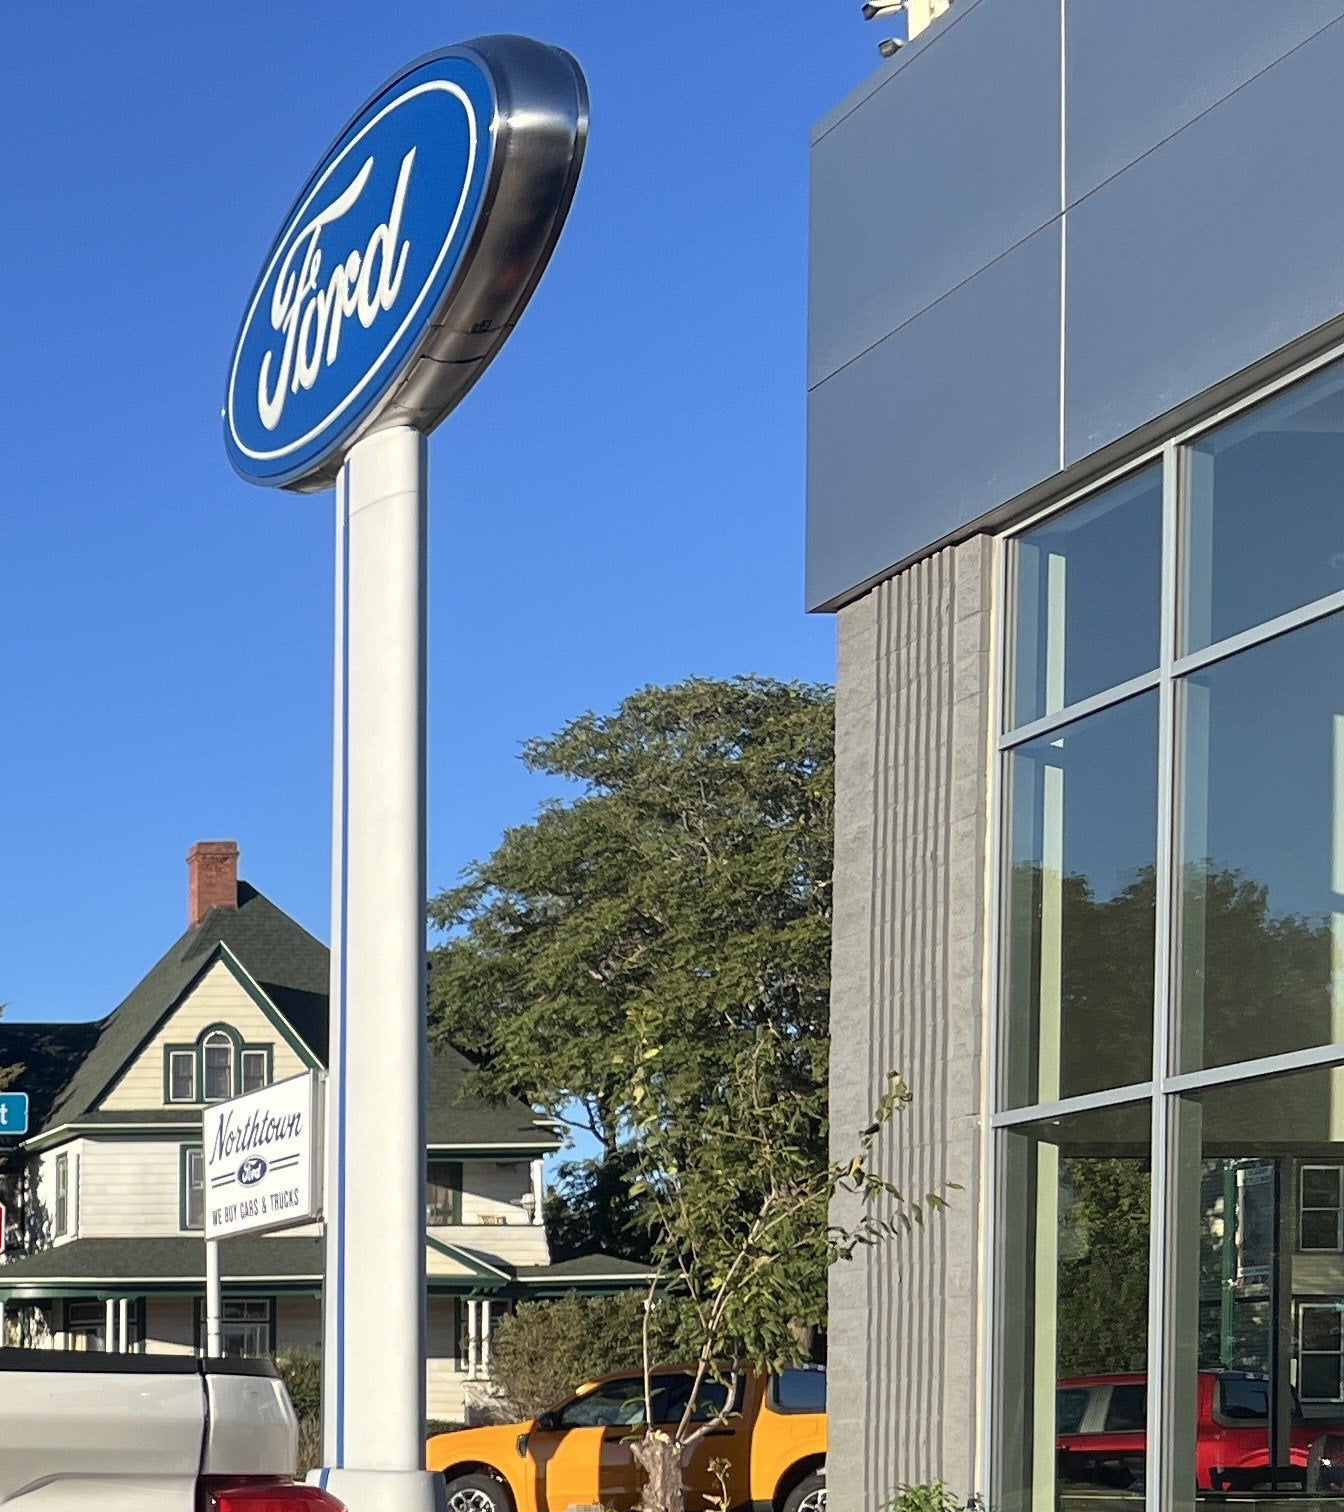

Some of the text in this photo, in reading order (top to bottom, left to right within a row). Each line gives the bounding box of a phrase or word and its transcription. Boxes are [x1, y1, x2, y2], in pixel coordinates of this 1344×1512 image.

[258, 146, 416, 430] Ford
[209, 1109, 303, 1166] Northtown
[212, 1187, 299, 1226] WE BUY CARS & TRUCKS
